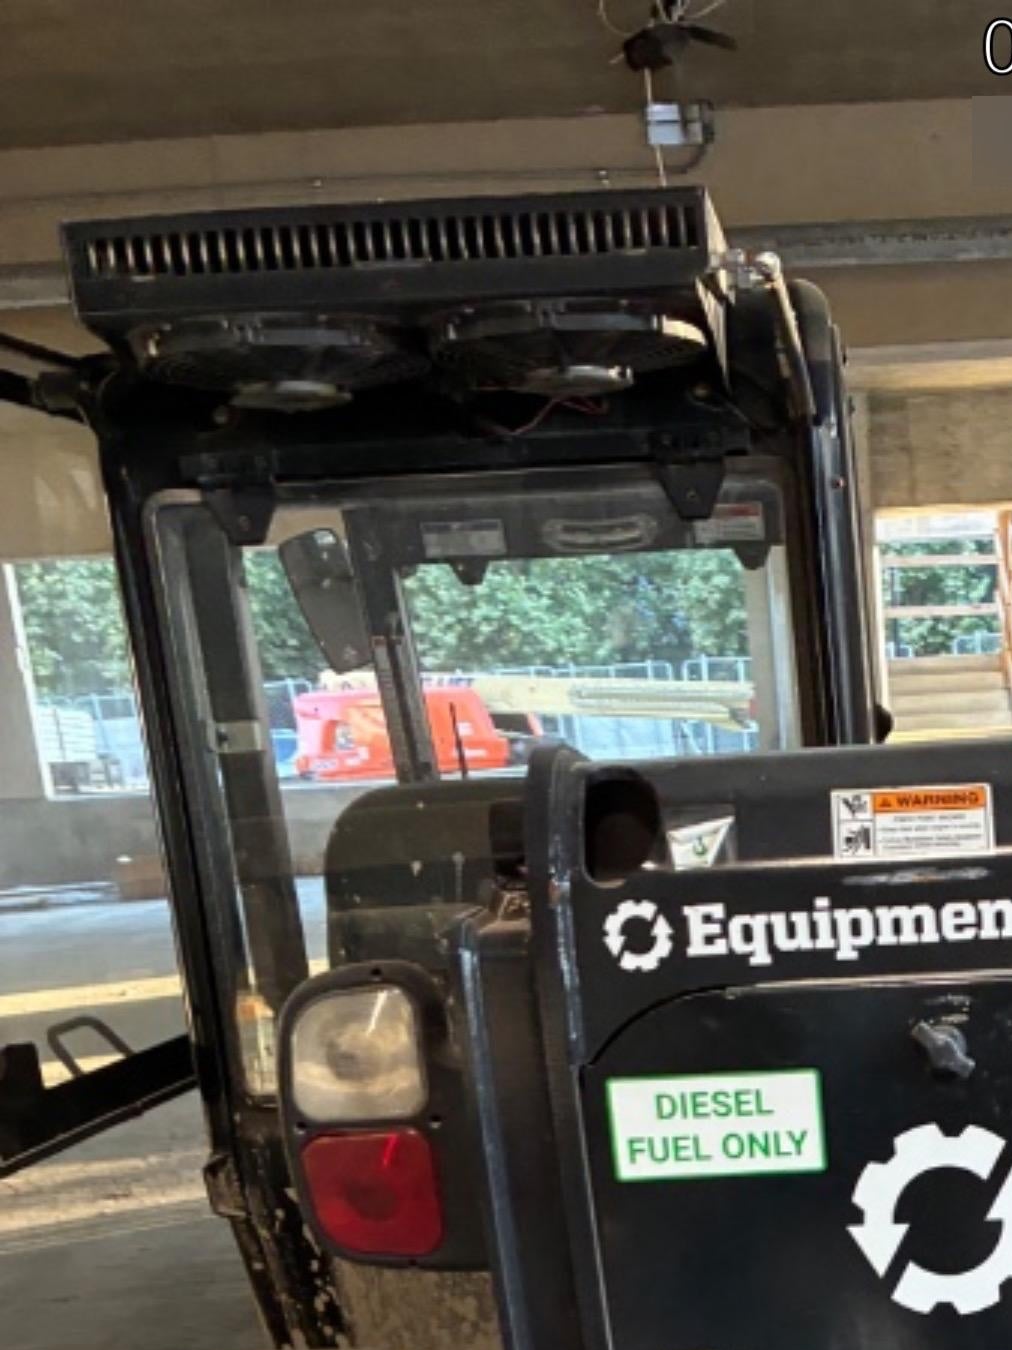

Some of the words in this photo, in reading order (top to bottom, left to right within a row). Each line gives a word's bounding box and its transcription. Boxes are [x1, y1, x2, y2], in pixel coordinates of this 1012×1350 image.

[896, 791, 979, 807] WARNING
[655, 1088, 774, 1120] DIESEL
[627, 1134, 713, 1164] FUEL
[721, 1129, 809, 1160] ONLY
